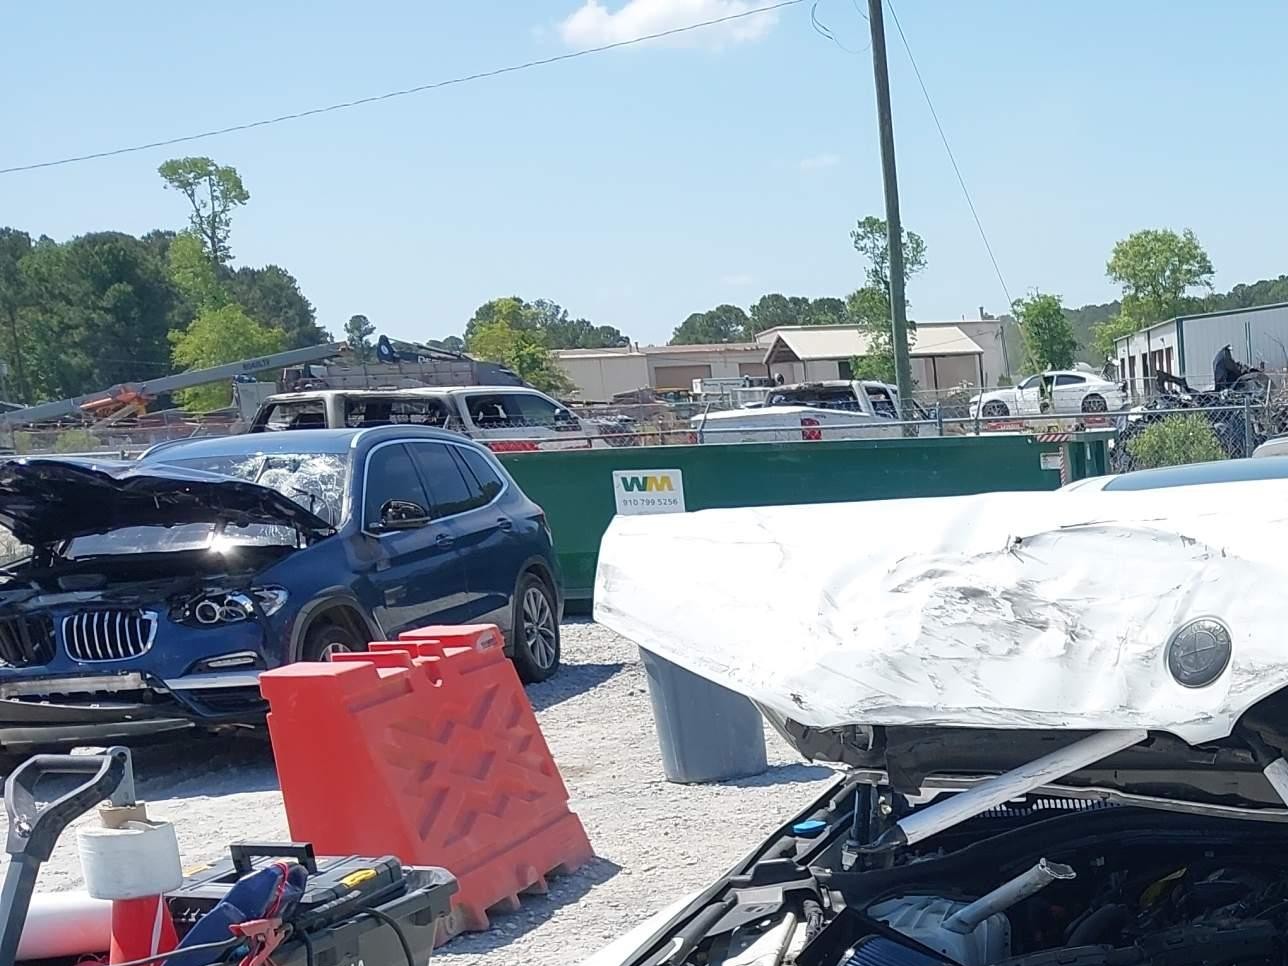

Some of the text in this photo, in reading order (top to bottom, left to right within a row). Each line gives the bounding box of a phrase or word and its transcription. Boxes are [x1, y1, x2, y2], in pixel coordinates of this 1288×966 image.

[621, 475, 674, 493] WM
[622, 498, 679, 506] 910 799 5256
